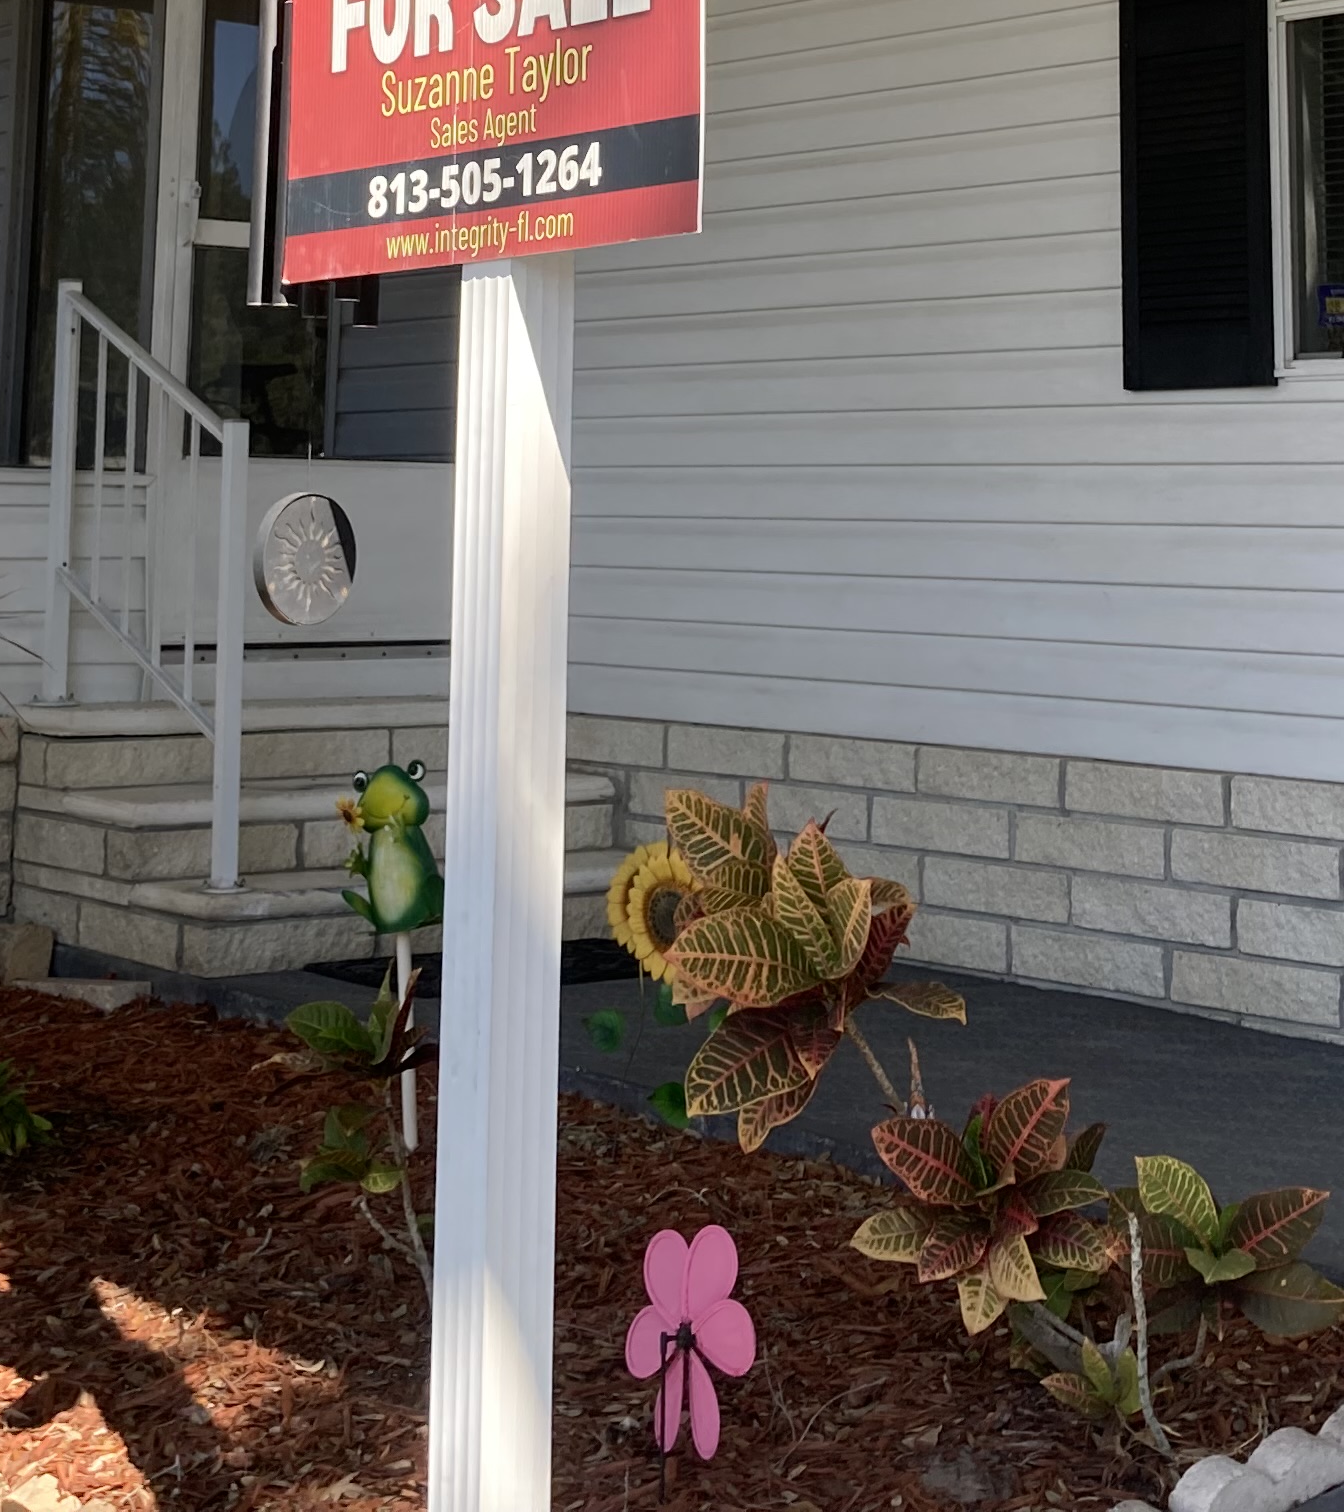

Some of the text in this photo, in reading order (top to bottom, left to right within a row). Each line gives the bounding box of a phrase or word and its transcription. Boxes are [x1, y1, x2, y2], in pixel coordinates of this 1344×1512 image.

[381, 38, 593, 117] Suzanne Taylor
[430, 105, 537, 149] Sales Agent
[367, 140, 602, 219] 813-505-1264
[386, 210, 574, 259] www.integrity-fl.com
